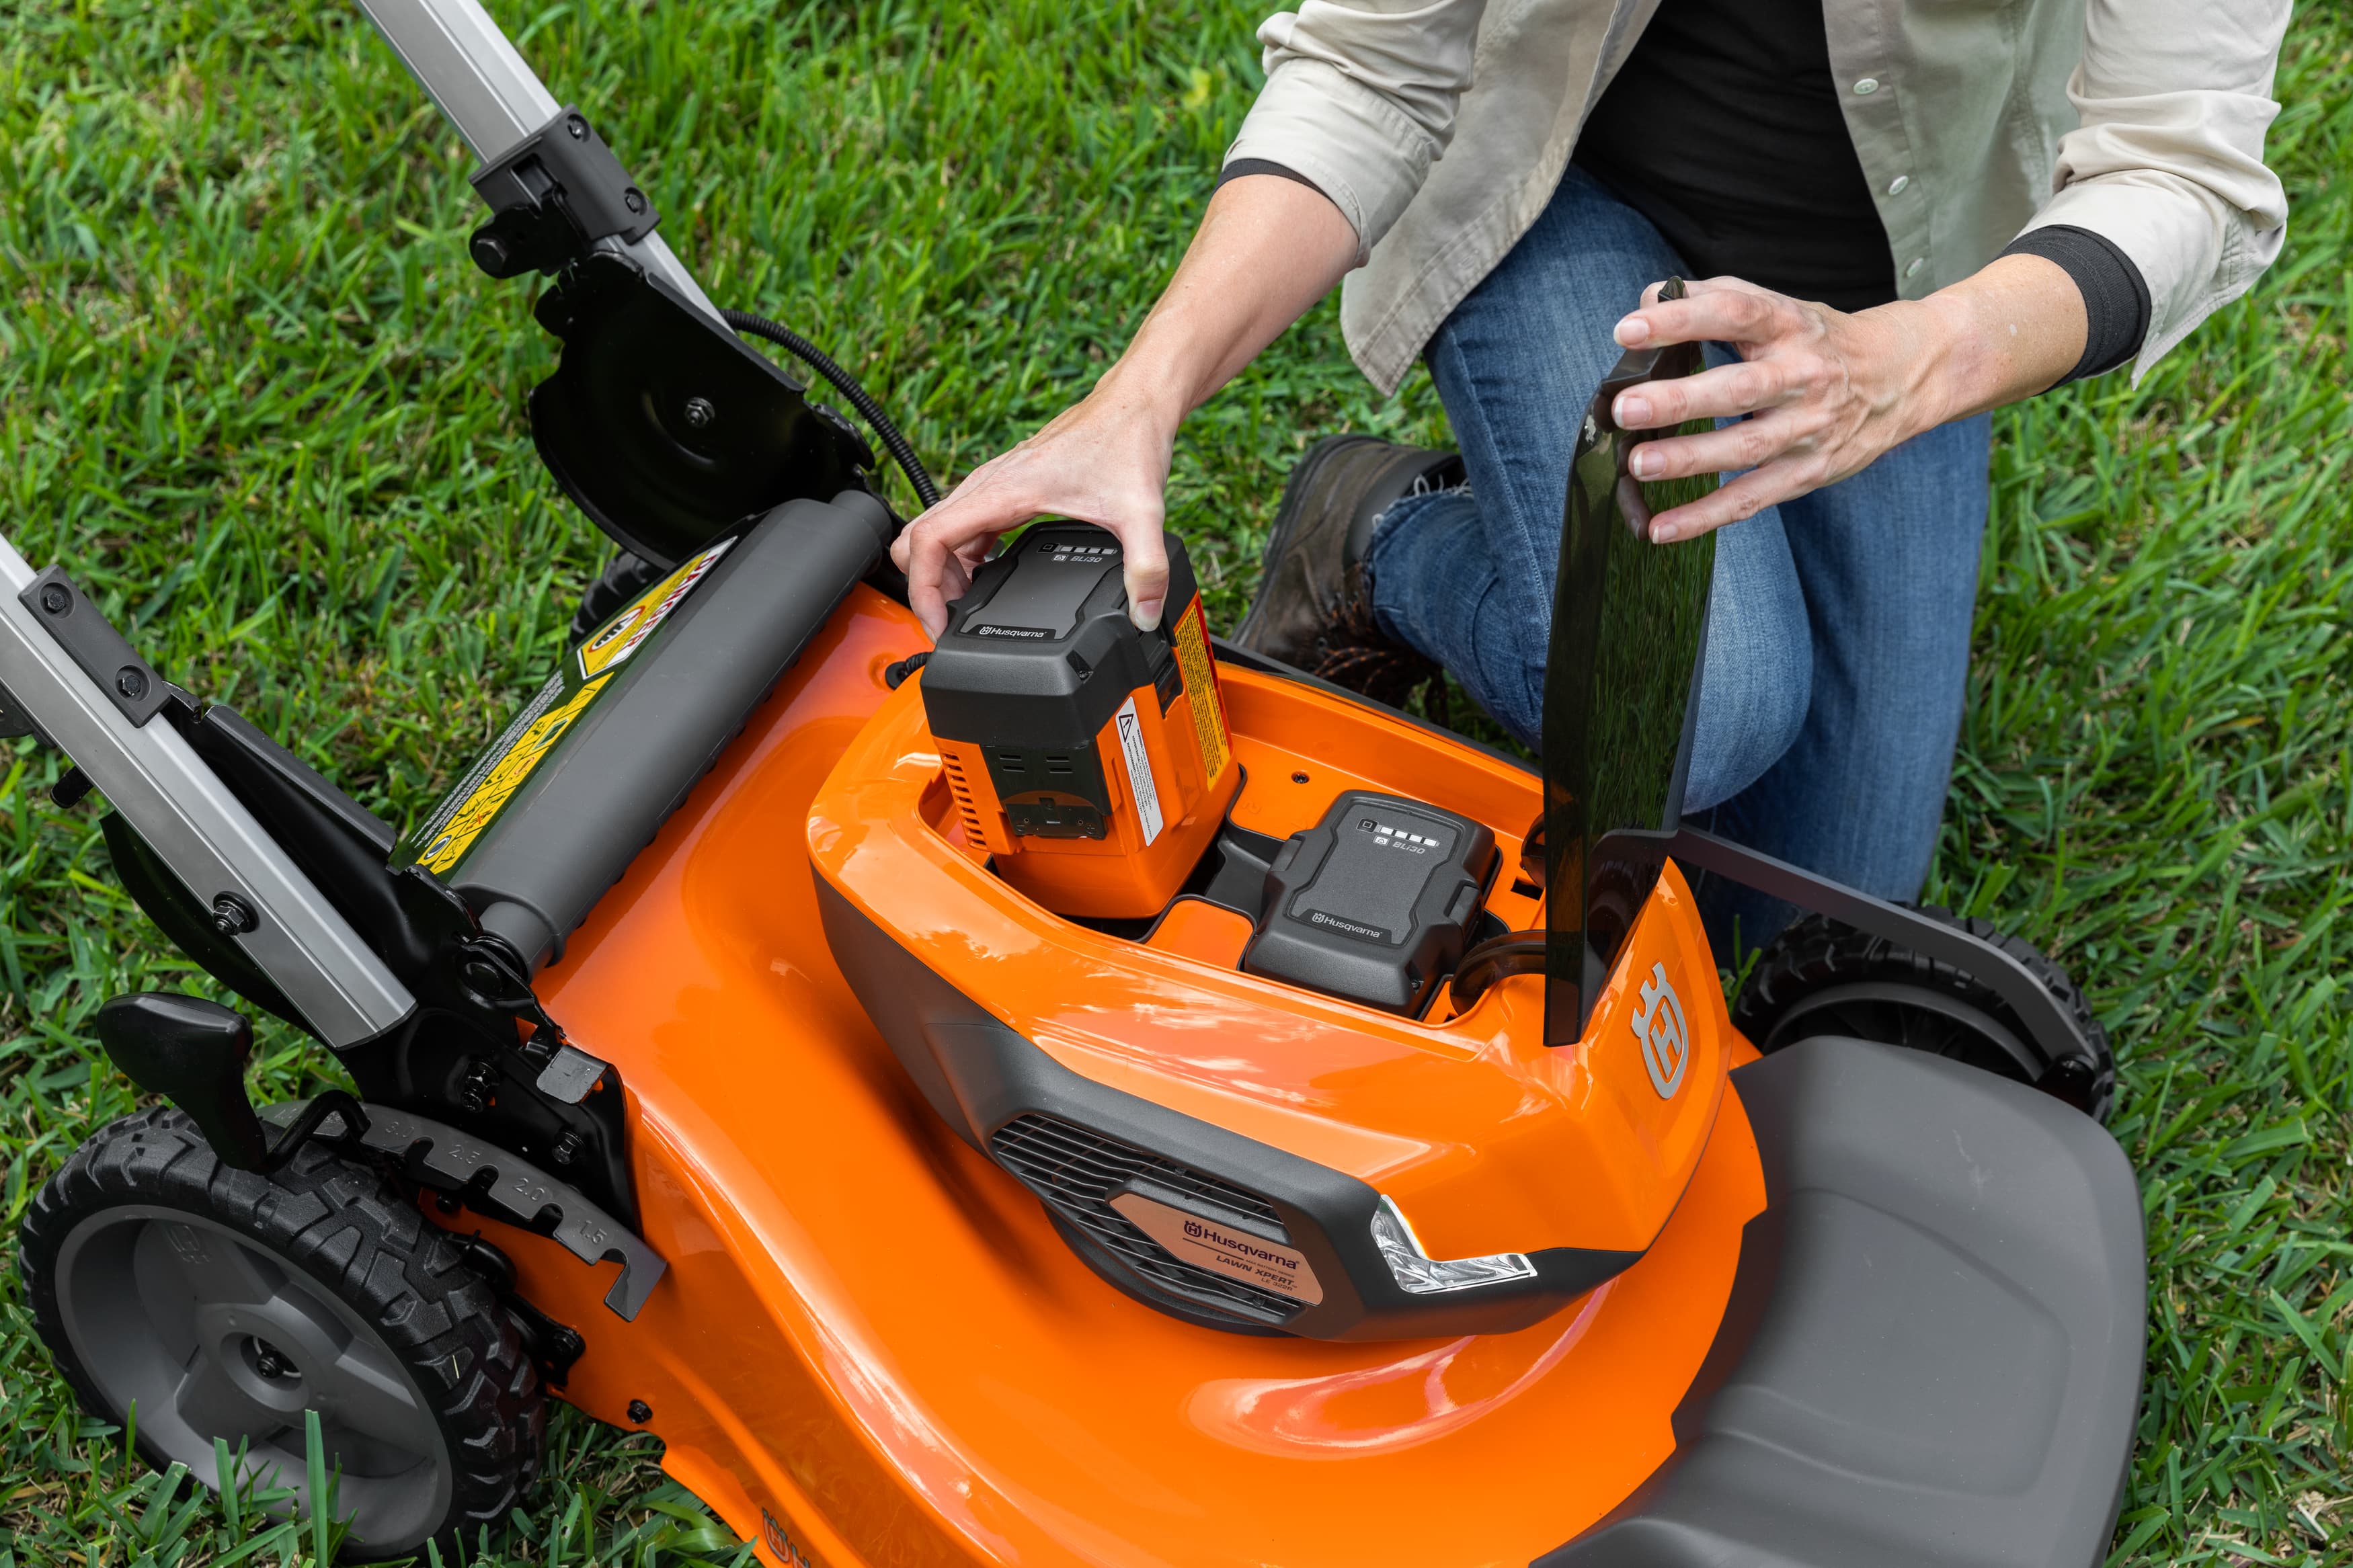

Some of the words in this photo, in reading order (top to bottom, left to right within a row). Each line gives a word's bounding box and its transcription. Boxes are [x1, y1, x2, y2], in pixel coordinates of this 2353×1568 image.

[617, 554, 717, 653] DANGER
[1392, 841, 1426, 854] BLi30
[513, 1178, 545, 1202] 2.0
[580, 1220, 607, 1244] 1.5
[1215, 1255, 1252, 1272] LAWN
